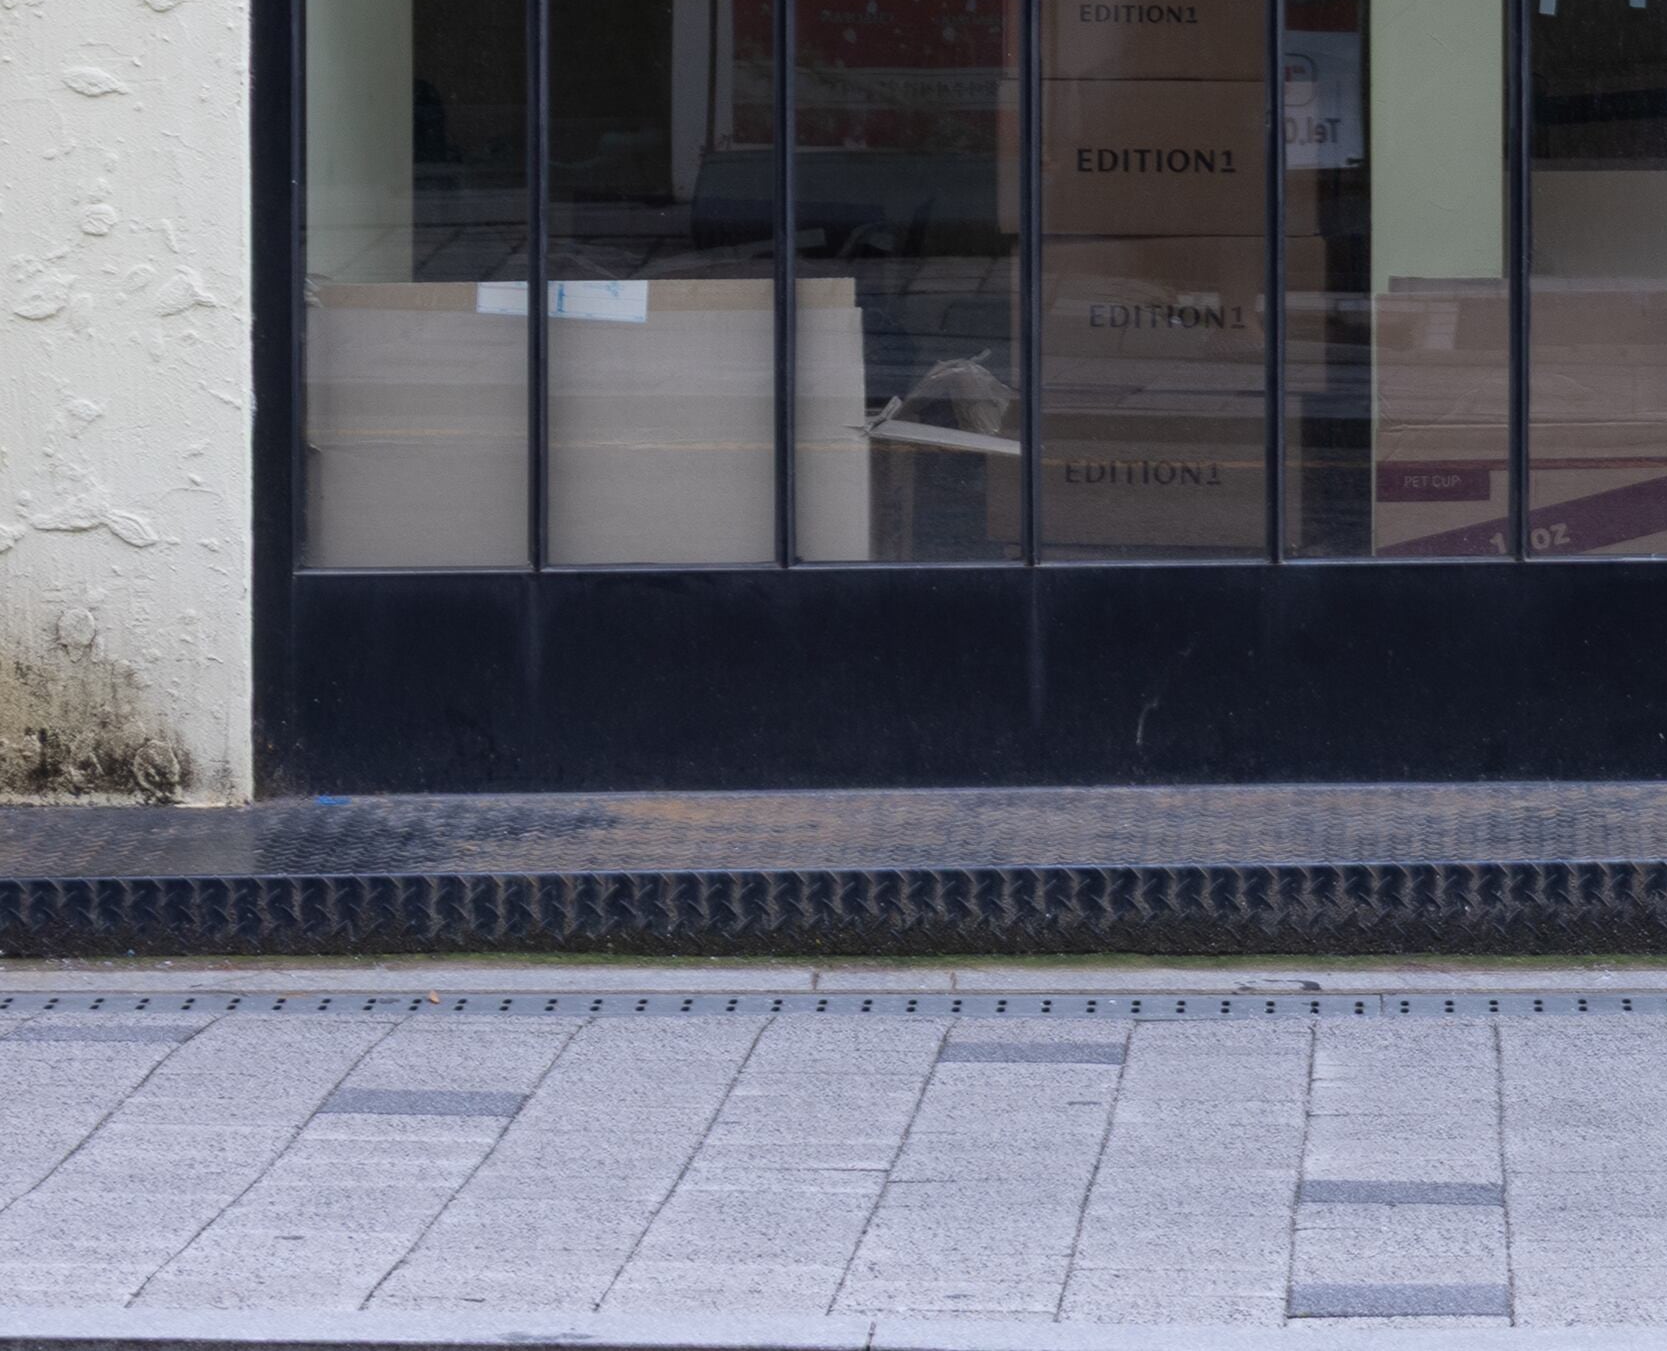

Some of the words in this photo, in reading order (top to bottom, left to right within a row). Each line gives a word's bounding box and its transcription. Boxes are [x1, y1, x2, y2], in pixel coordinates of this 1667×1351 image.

[1079, 3, 1199, 25] EDITION1
[1076, 147, 1237, 175] EDITION1
[1089, 304, 1246, 330] EDITION1
[1064, 460, 1222, 487] EDITION1
[1403, 475, 1429, 489] PET
[1431, 475, 1462, 489] CUP
